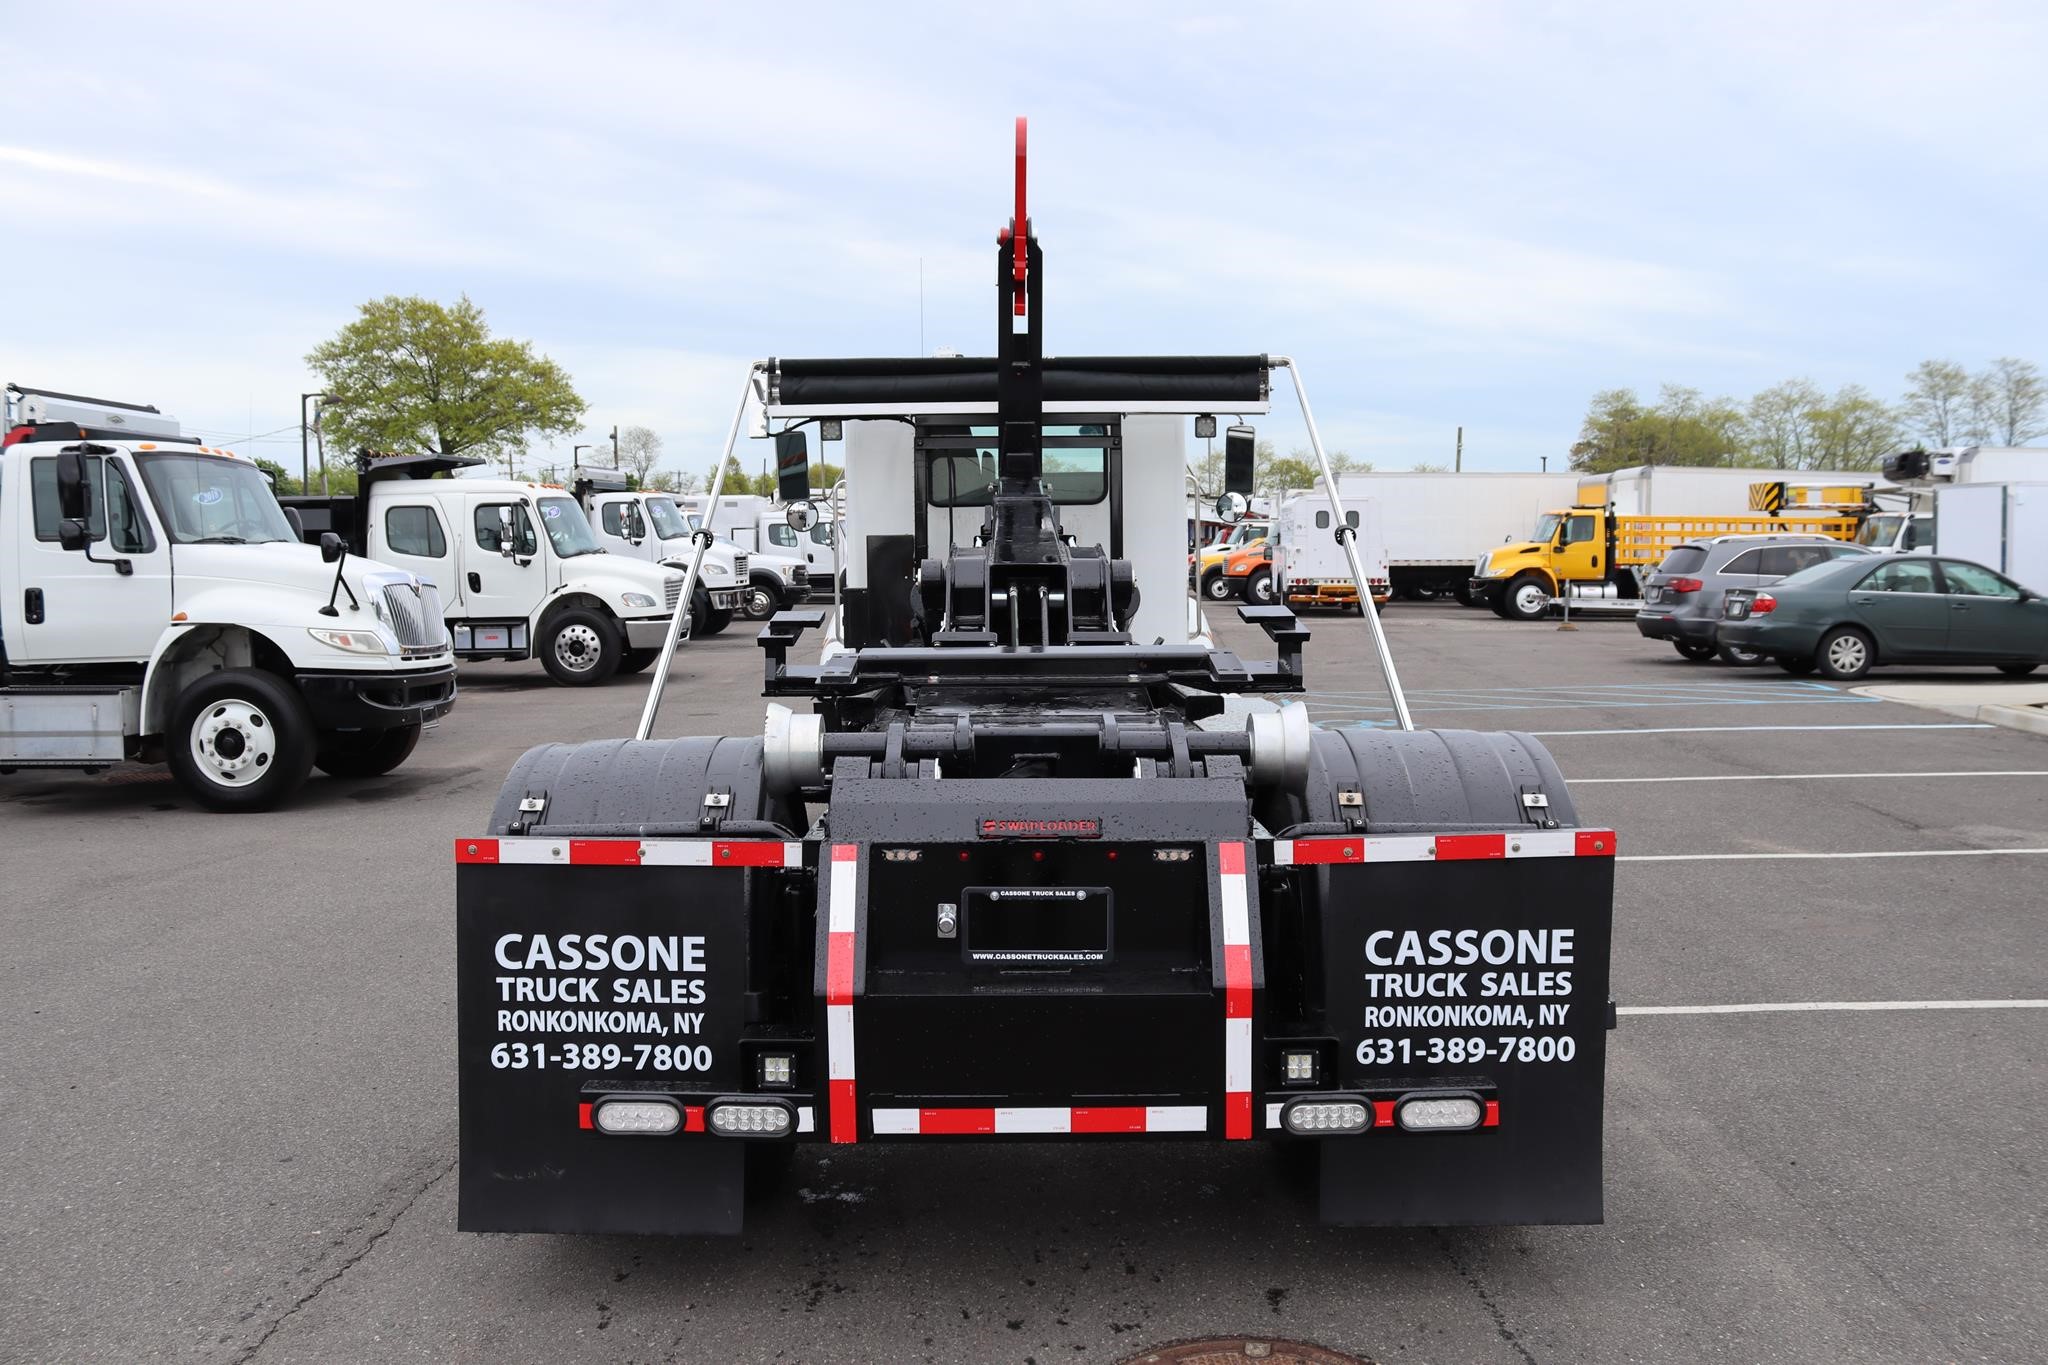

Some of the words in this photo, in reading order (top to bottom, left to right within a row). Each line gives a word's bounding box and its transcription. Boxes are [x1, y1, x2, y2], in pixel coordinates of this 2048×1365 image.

[998, 819, 1097, 832] SWAPLOADER
[494, 933, 707, 972] CASSONE
[972, 953, 1104, 961] WWW.CASSONETRUCKSALES.COM
[1365, 928, 1575, 966] CASSONE
[495, 976, 600, 1003] TRUCK
[612, 977, 706, 1005] SALES
[1364, 972, 1468, 998] TRUCK
[1480, 971, 1573, 997] SALES
[497, 1009, 669, 1038] RONKONKOMA,
[673, 1012, 705, 1035] NY
[1364, 1004, 1535, 1029] RONKONKOMA,
[1539, 1003, 1571, 1026] NY
[490, 1042, 713, 1072] 631-389-7800
[1356, 1035, 1576, 1065] 631-389-7800
